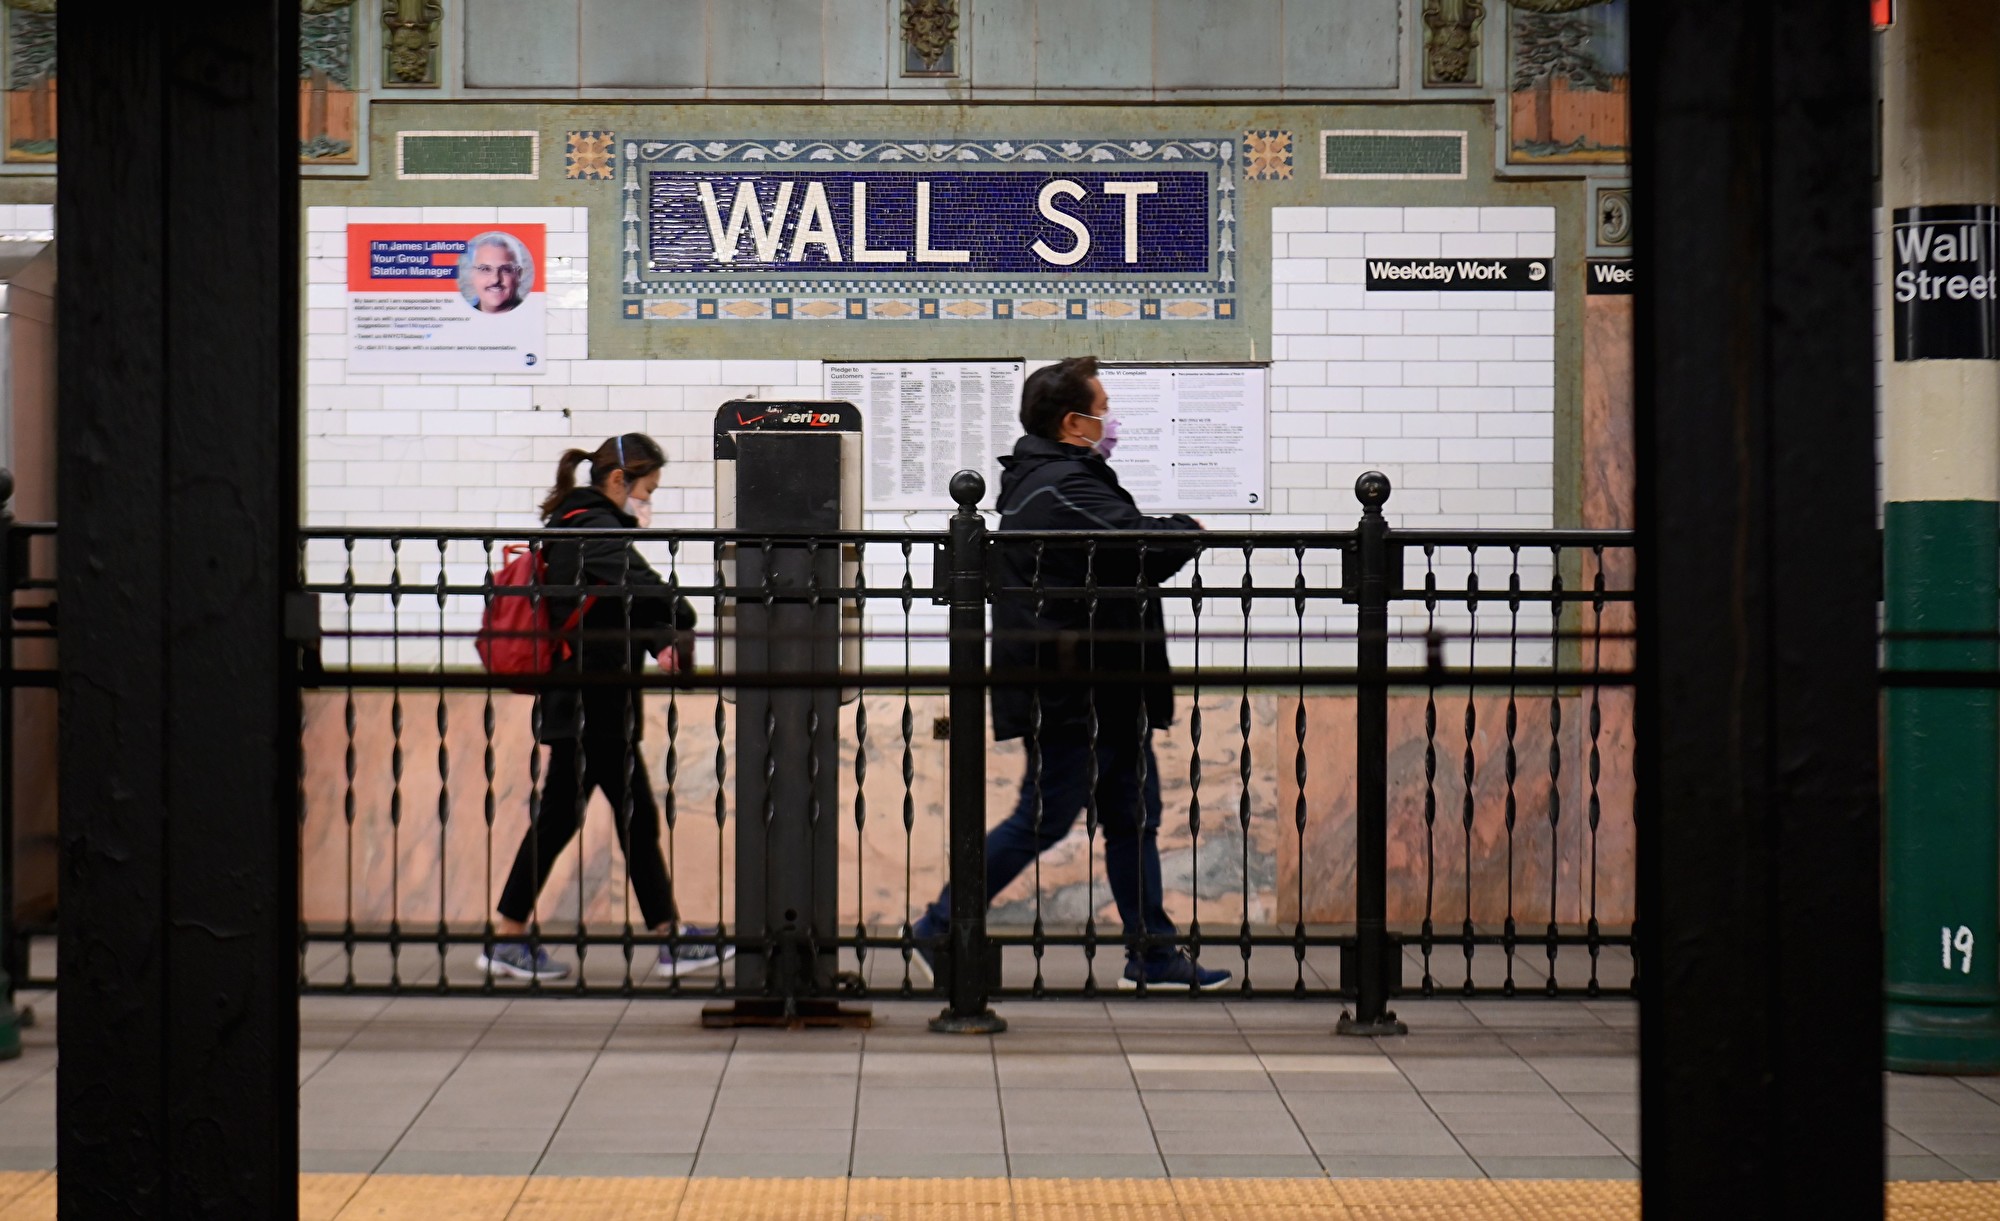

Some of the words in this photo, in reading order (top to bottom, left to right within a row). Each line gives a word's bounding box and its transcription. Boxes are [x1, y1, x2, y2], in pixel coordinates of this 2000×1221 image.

[696, 180, 971, 264] WALL
[1030, 178, 1159, 267] ST
[373, 241, 388, 251] I'm
[390, 241, 423, 251] James
[425, 241, 466, 251] LaMorte
[1895, 224, 1978, 265] Wall
[373, 254, 396, 263] Your
[398, 253, 429, 265] Group
[373, 266, 408, 276] Station
[410, 266, 453, 278] Manager
[1369, 261, 1455, 283] Weekday
[1457, 261, 1508, 279] Work
[1895, 268, 1997, 303] Street
[830, 366, 852, 374] Pledge
[1942, 925, 1974, 974] 19
